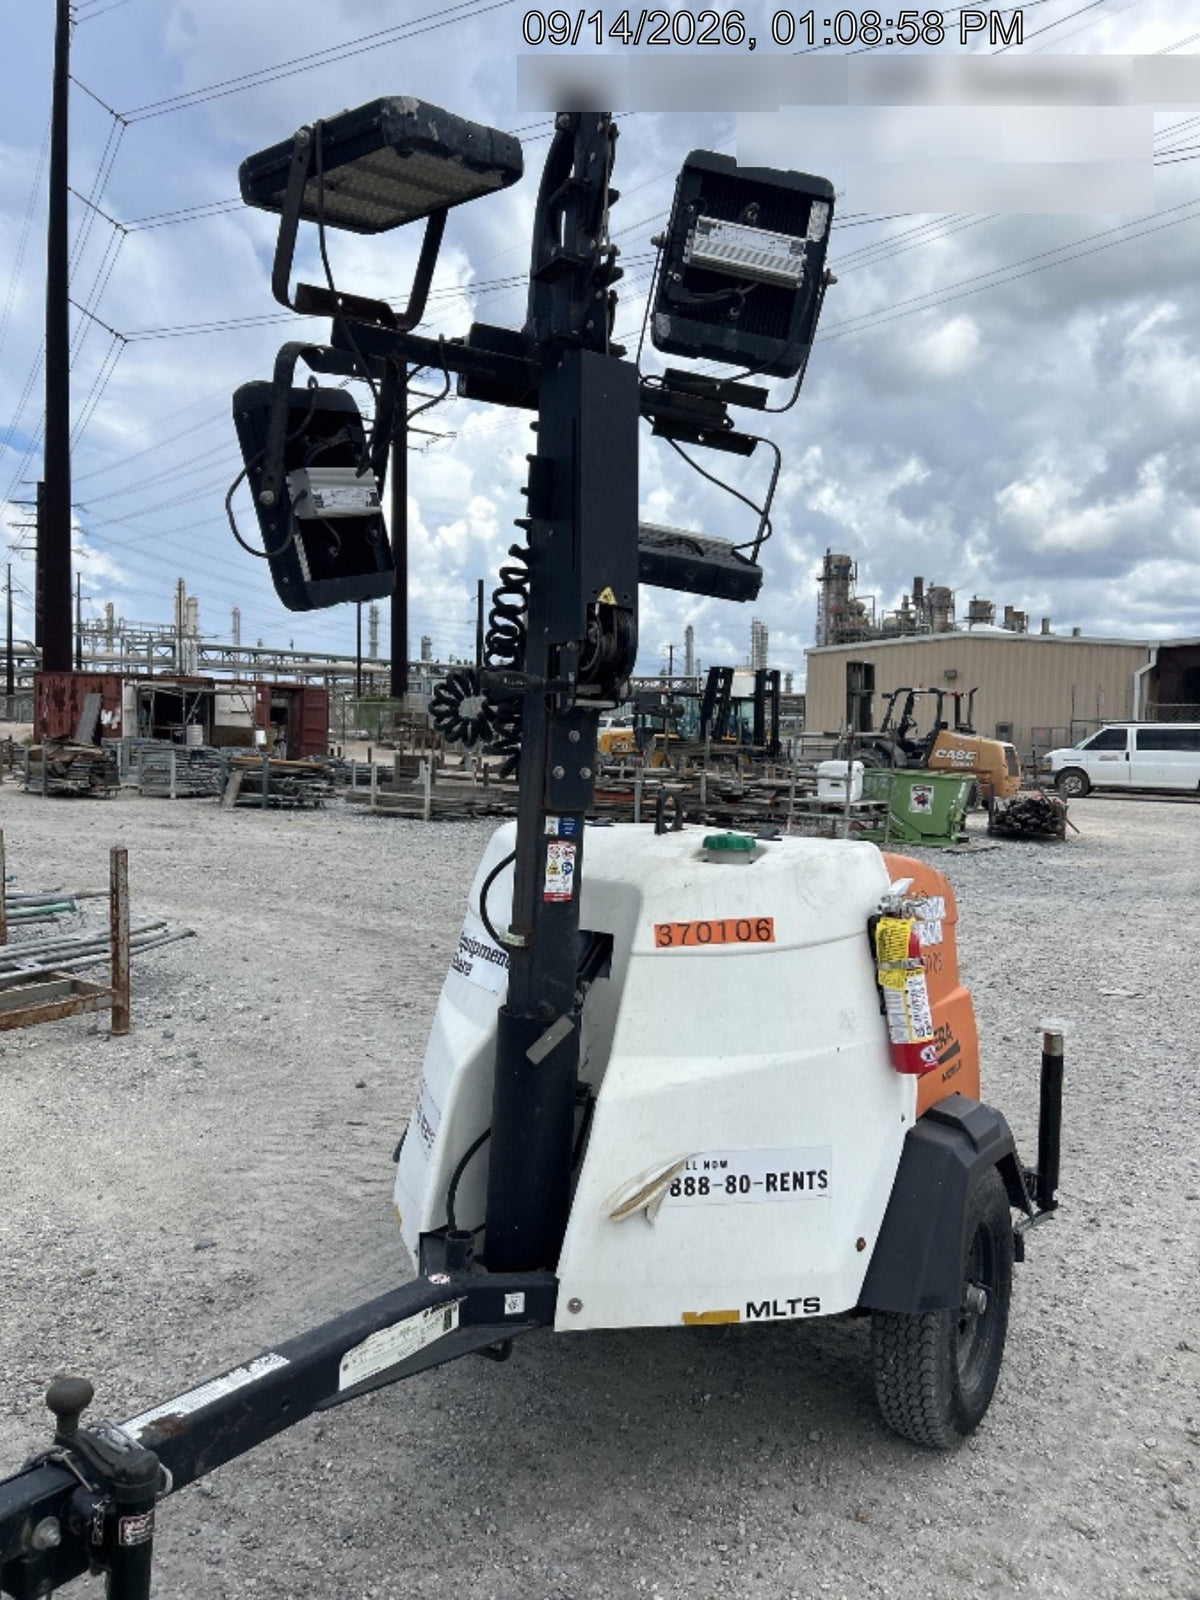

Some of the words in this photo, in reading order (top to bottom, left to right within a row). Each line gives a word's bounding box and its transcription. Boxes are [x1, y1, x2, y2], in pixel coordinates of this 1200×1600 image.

[934, 749, 977, 761] CASE
[658, 918, 771, 947] 370106
[685, 1160, 698, 1171] LL
[703, 1159, 728, 1170] NOW
[746, 1297, 821, 1318] MLTS
